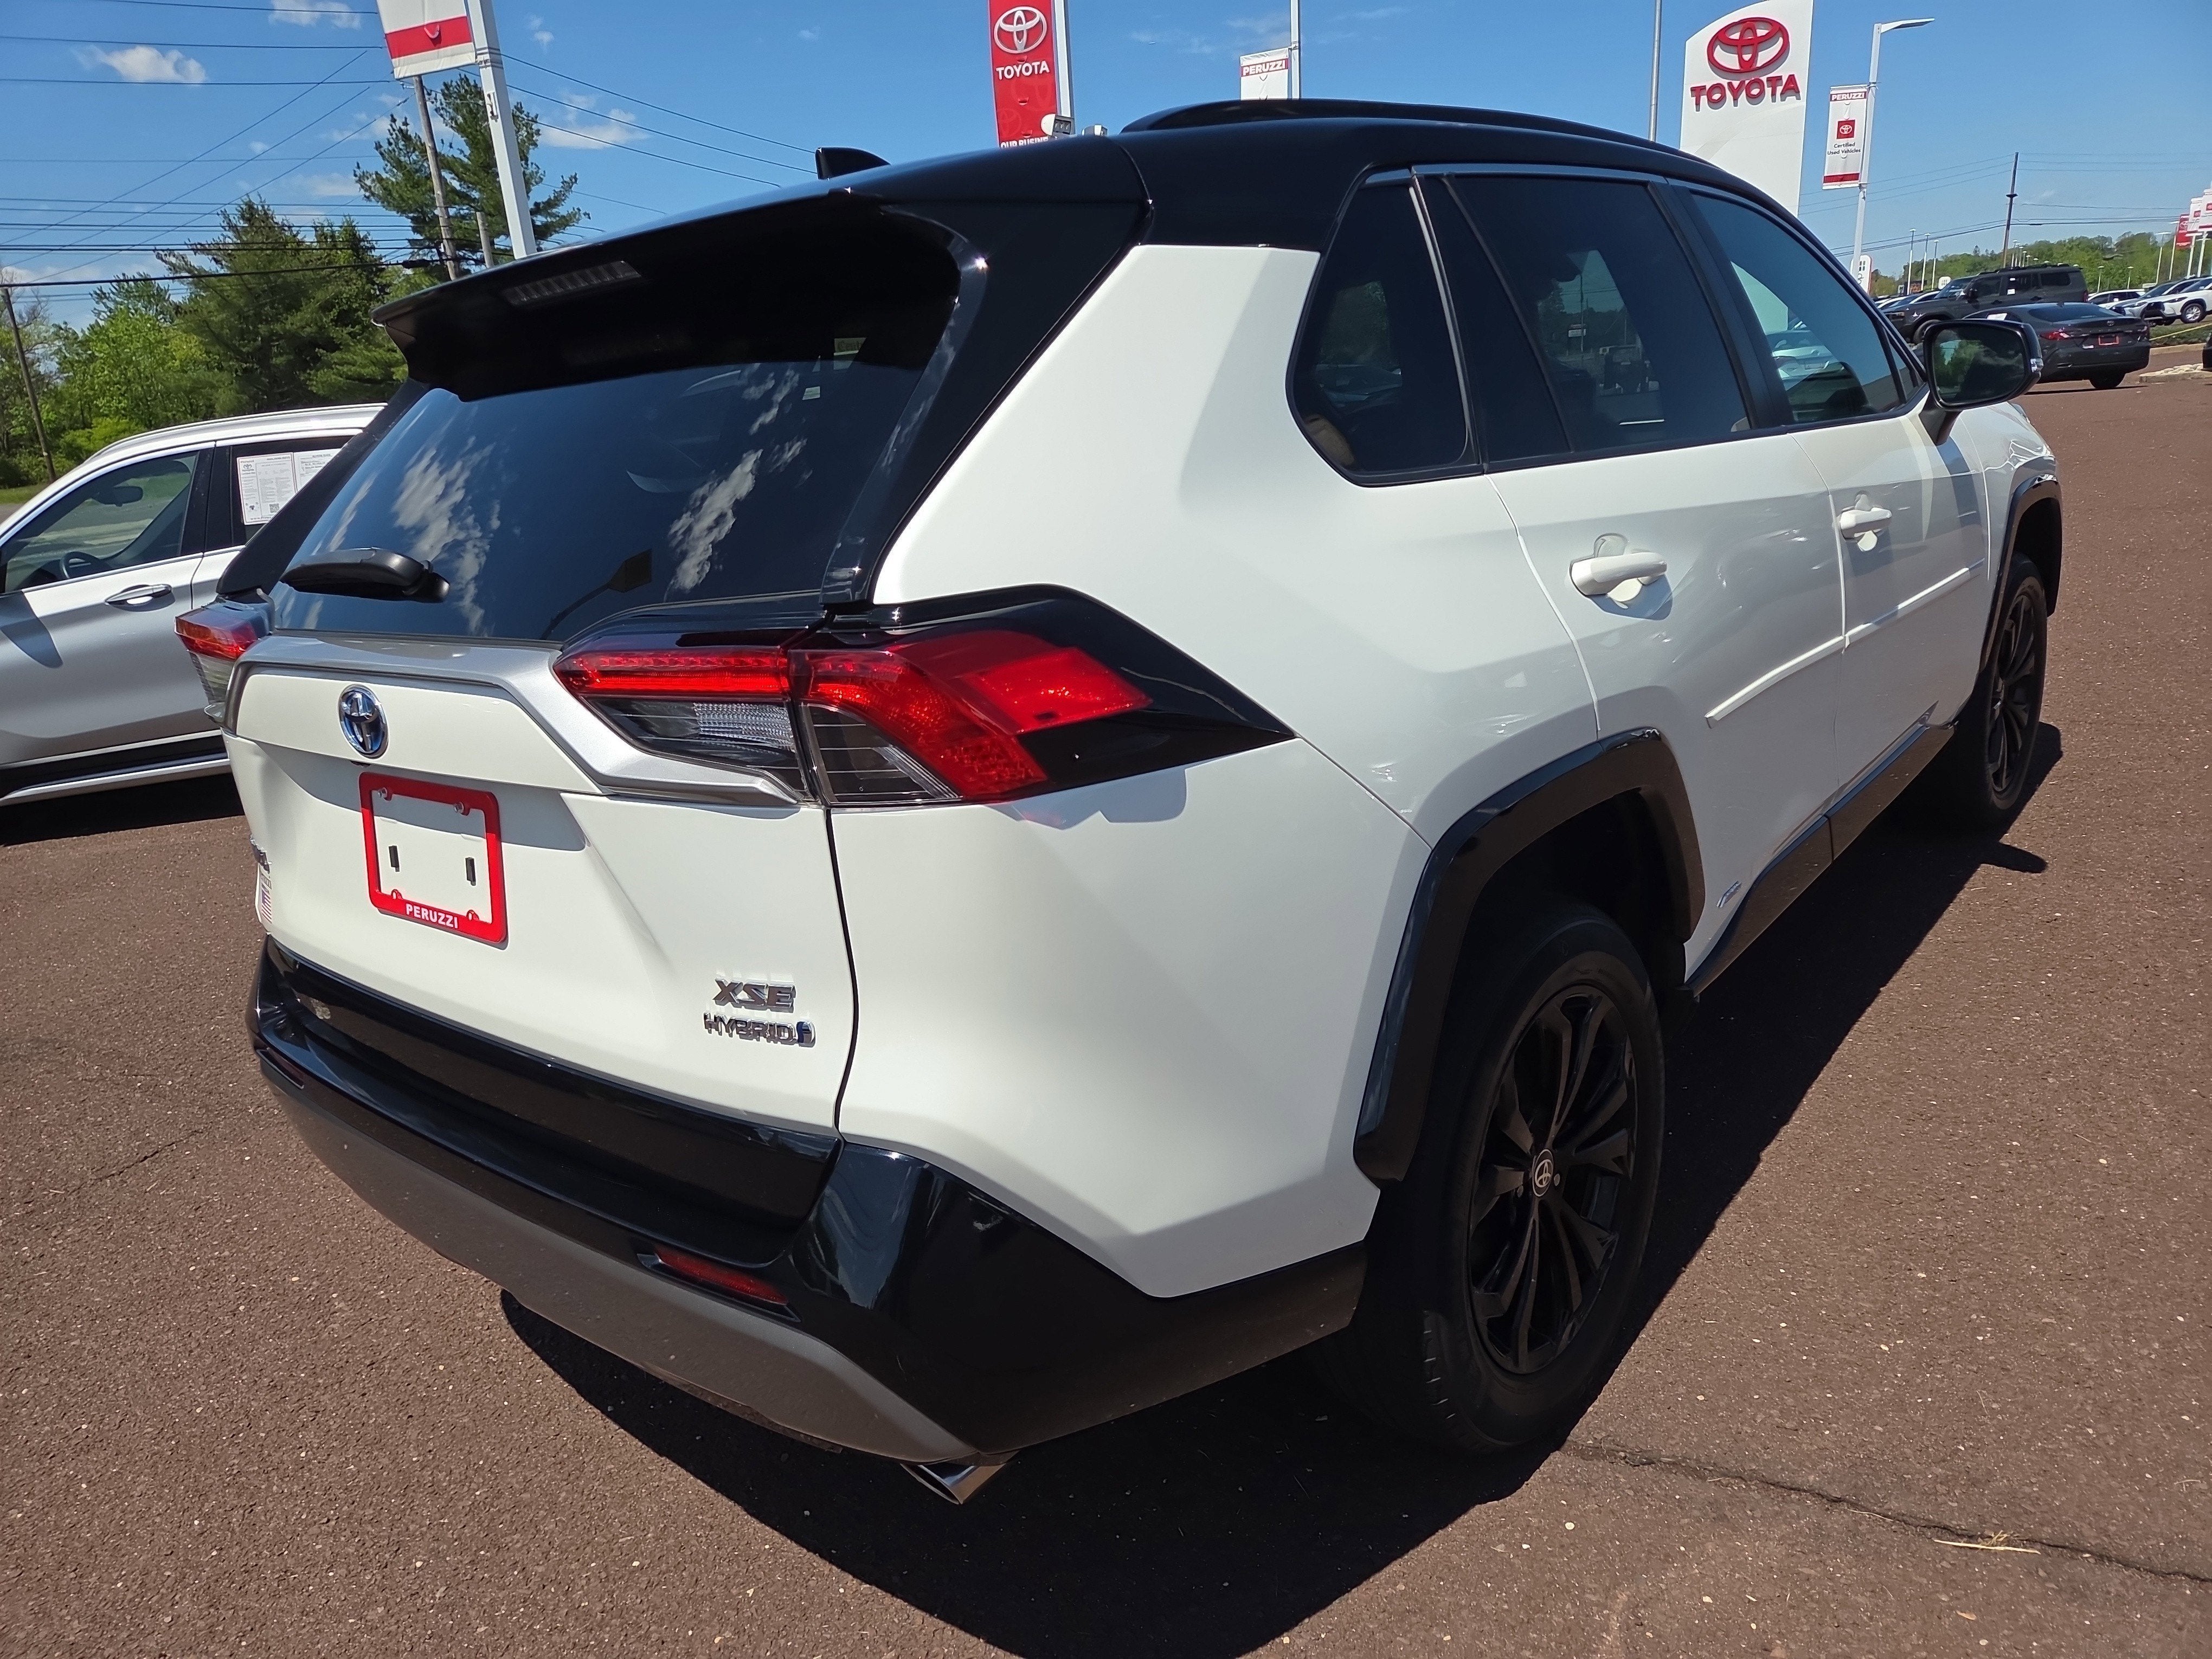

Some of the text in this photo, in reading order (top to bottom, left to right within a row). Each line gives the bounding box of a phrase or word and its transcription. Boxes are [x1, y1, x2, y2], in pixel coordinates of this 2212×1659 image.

[996, 61, 1050, 80] TOYOTA
[1243, 60, 1285, 76] PERUZZI
[1690, 74, 1801, 110] TOYOTA
[1831, 92, 1865, 101] PERUZZI
[406, 903, 458, 929] PERUZZI
[712, 978, 796, 1013] XSE
[704, 1012, 798, 1045] HYBRID
